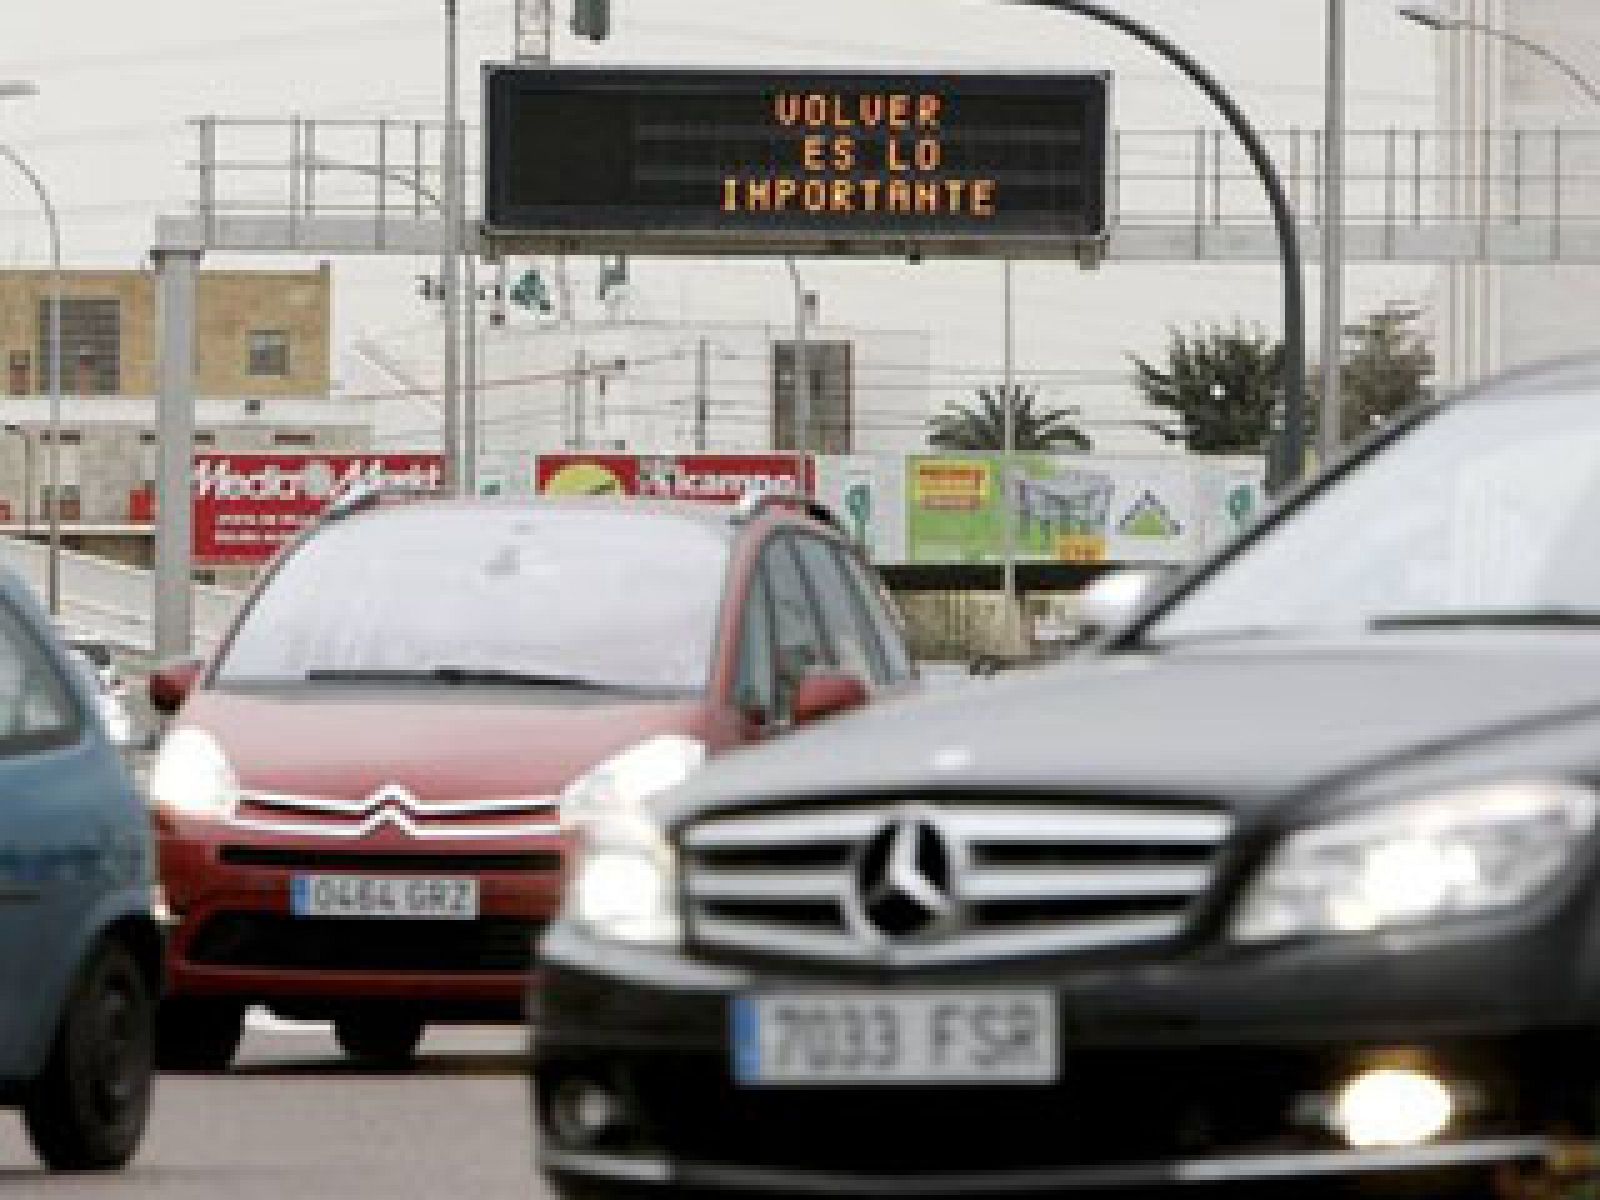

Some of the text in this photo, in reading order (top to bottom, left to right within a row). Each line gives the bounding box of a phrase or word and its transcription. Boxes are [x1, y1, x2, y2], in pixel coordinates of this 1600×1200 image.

[774, 94, 941, 128] VOLVER
[804, 135, 941, 170] ES LO
[724, 179, 997, 215] IMPORTANTE
[774, 1000, 1041, 1071] 7033 FSR
